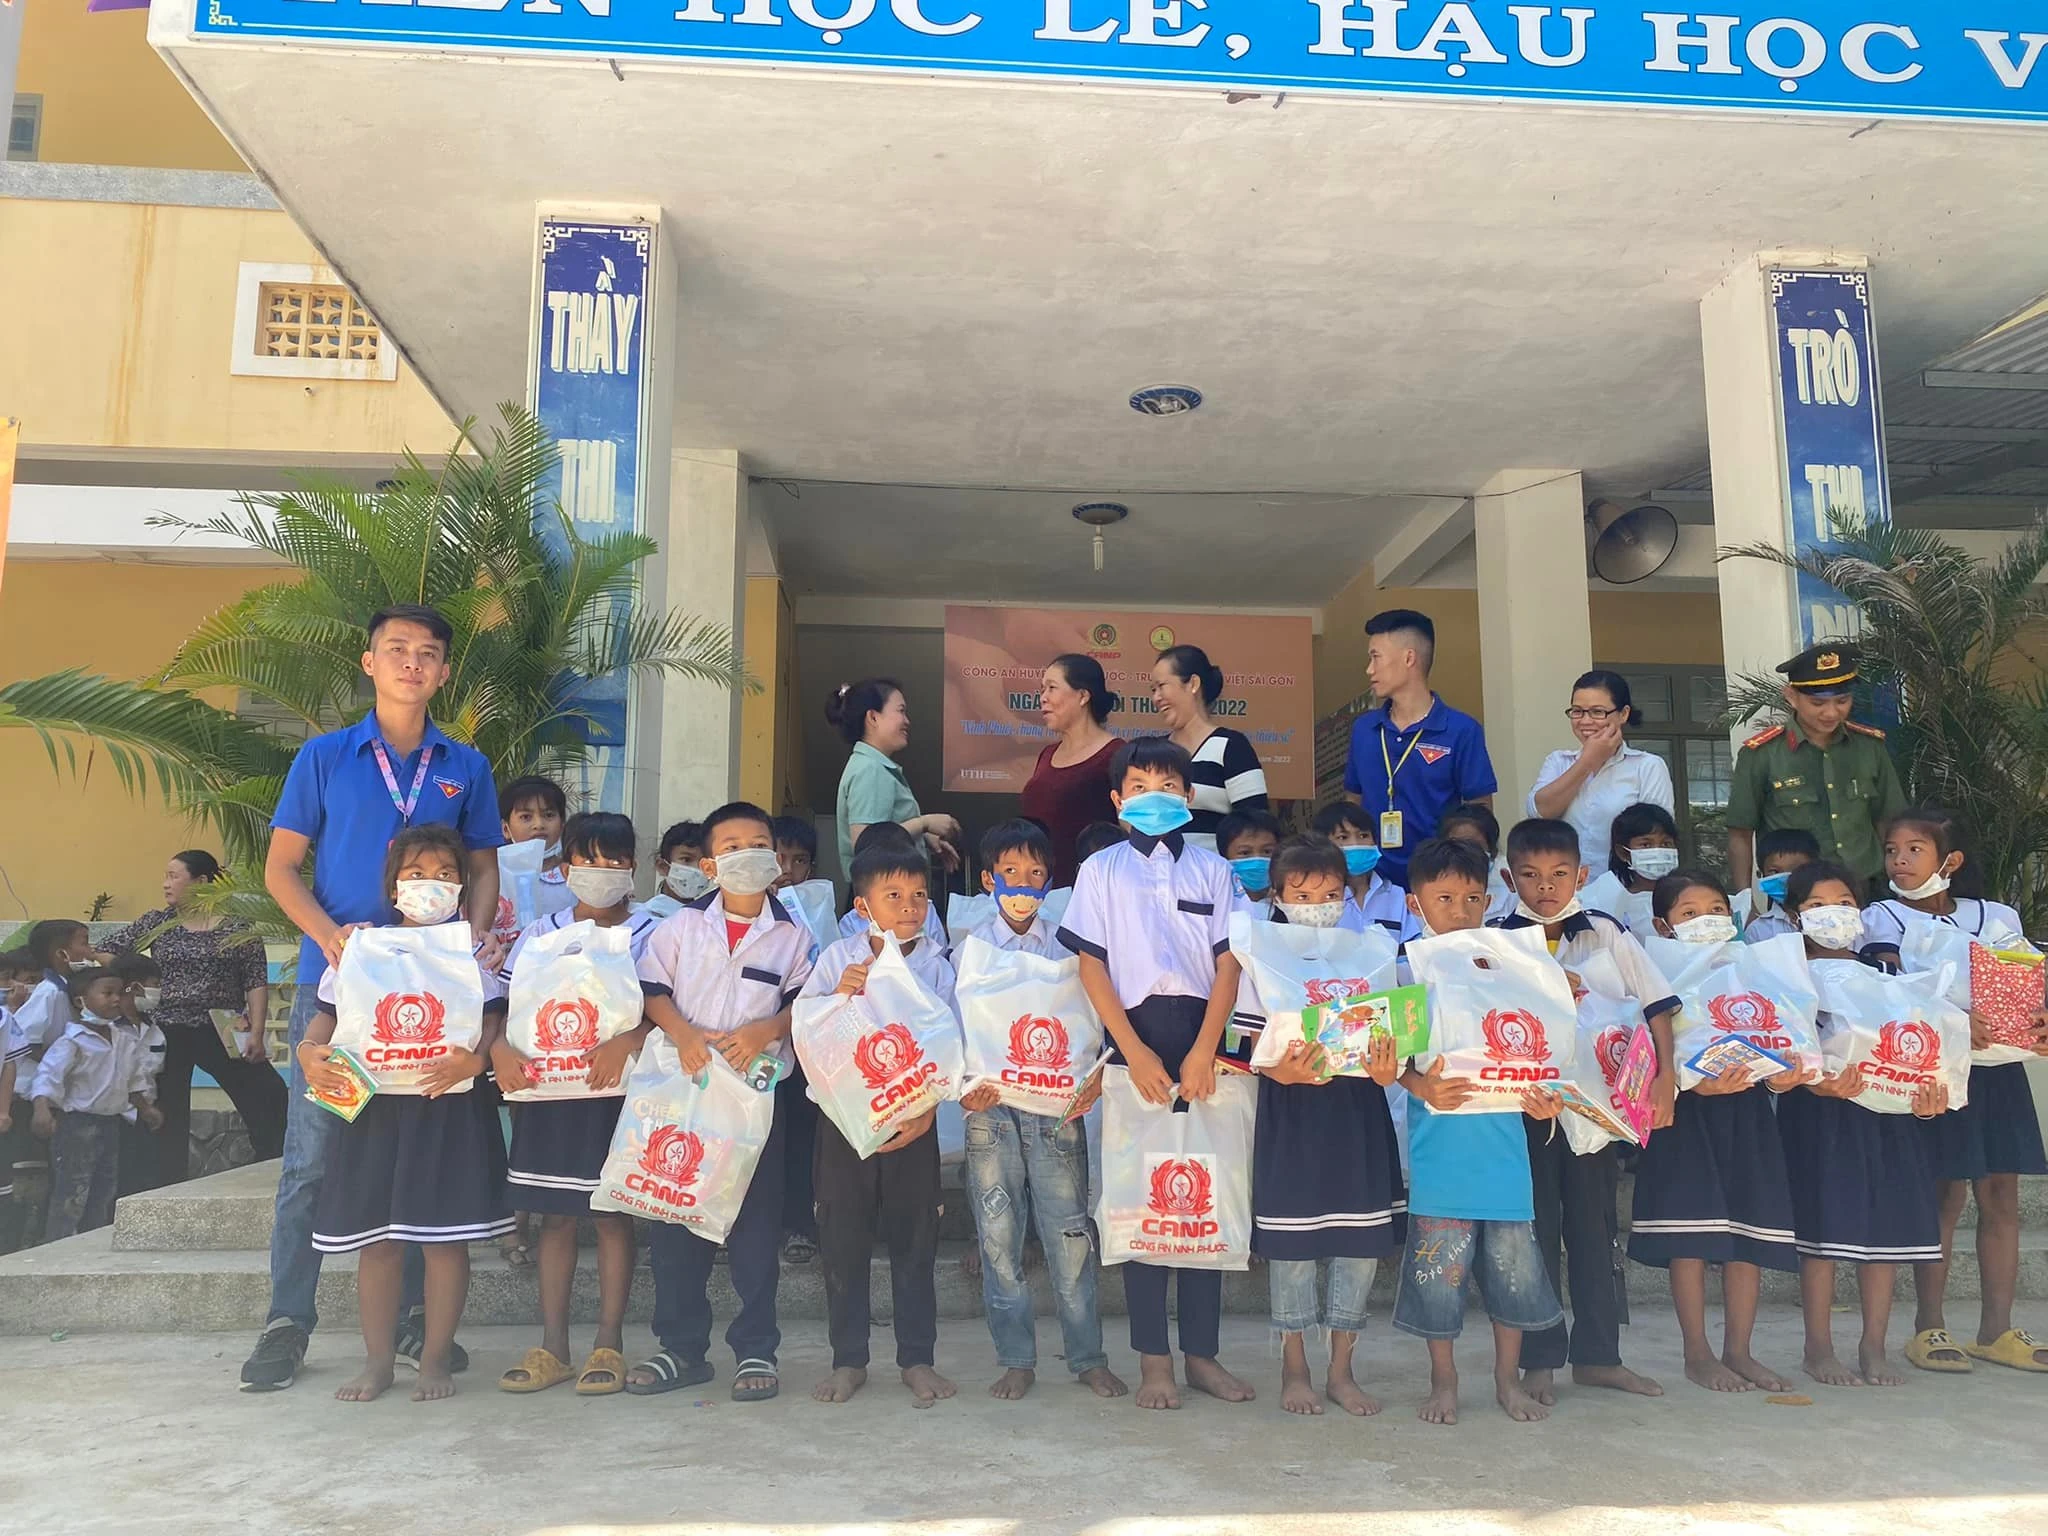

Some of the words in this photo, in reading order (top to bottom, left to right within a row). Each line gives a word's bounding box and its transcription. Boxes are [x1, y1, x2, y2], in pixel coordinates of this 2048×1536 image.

[1642, 12, 1924, 93] HỌC
[548, 255, 639, 375] THẦY
[1788, 308, 1861, 408] TRÒ
[558, 437, 617, 524] THI
[1805, 464, 1868, 543] THI
[1009, 689, 1042, 711] NGÀ
[1211, 699, 1247, 716] 2022
[365, 1045, 448, 1063] CANP
[530, 1055, 594, 1072] CAN
[870, 1061, 938, 1113] CANP
[1001, 1068, 1075, 1088] CANP
[1479, 1066, 1561, 1082] CANP
[1858, 1061, 1937, 1085] CANP
[625, 1173, 697, 1208] CANP
[1141, 1218, 1219, 1238] CANP
